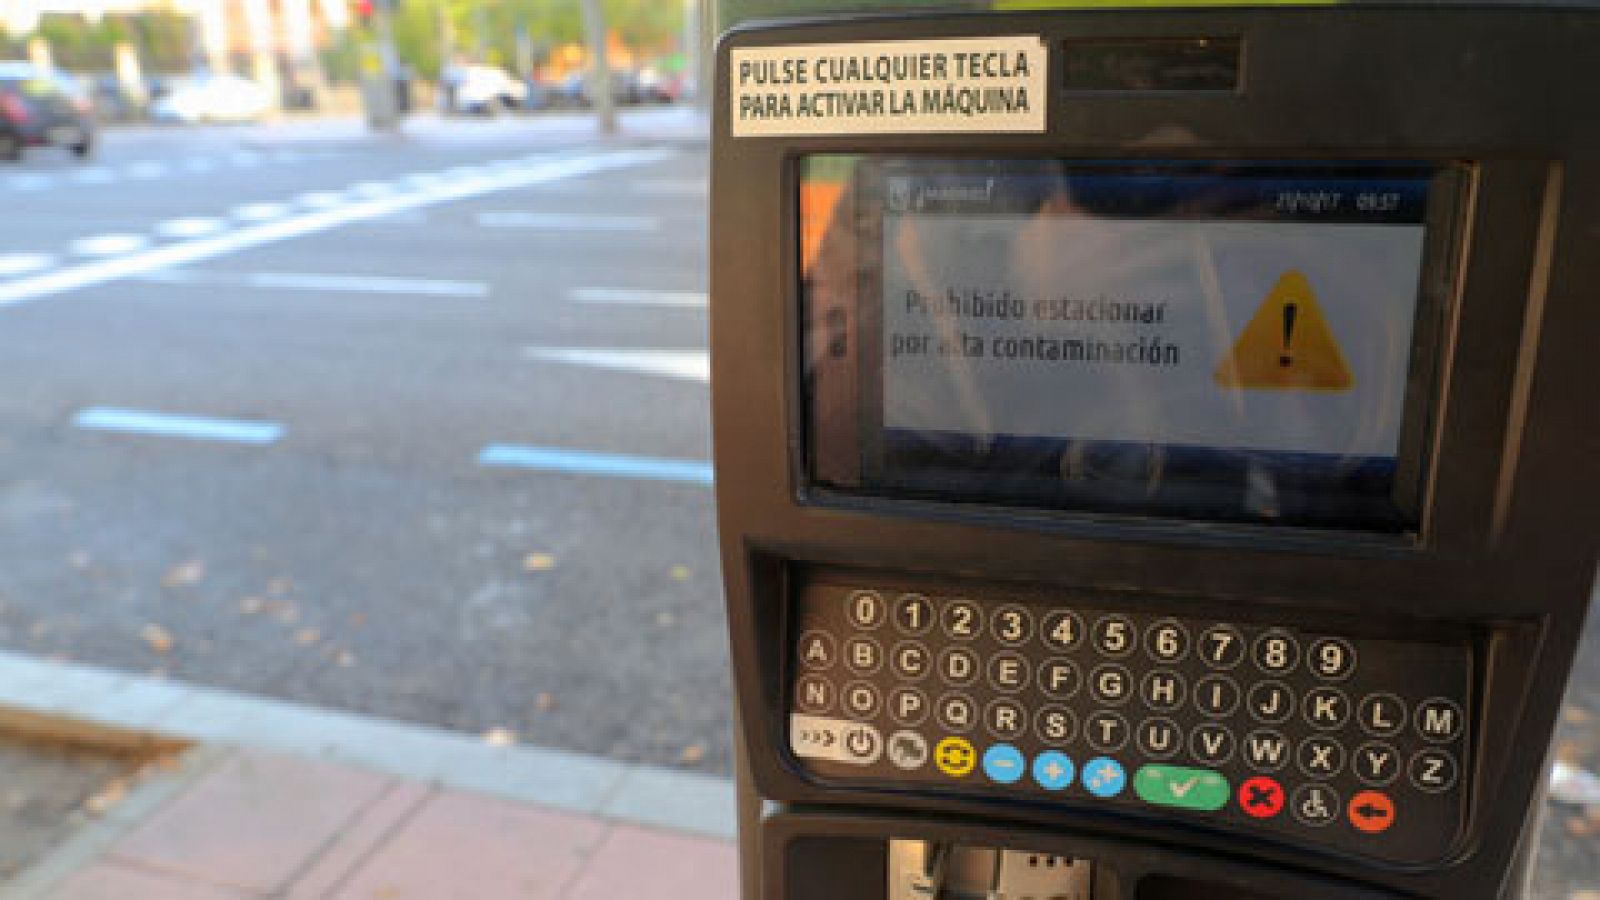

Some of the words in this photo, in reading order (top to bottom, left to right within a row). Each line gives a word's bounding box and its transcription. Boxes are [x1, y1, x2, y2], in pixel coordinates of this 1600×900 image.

[740, 59, 808, 84] PULSE
[815, 52, 948, 84] CUALQUIER
[953, 50, 1030, 78] TECLA
[740, 92, 792, 119] PARA
[796, 88, 884, 117] ACTIVAR
[889, 88, 917, 114] LA
[922, 83, 1030, 116] MÁQUINA
[1033, 295, 1166, 323] estacionar
[890, 334, 931, 359] por
[993, 335, 1180, 365] contaminación
[856, 596, 874, 624] 0
[906, 602, 919, 628] 1
[952, 606, 971, 634] 2
[1002, 612, 1021, 641] 3
[1052, 619, 1071, 645] 4
[1105, 622, 1124, 651] 5
[1156, 629, 1178, 655] 6
[1212, 633, 1231, 661] 7
[1265, 639, 1287, 668] 8
[1322, 645, 1341, 674] 9
[806, 639, 828, 661] A
[853, 642, 874, 667] B
[899, 649, 921, 671] C
[949, 653, 971, 678] D
[999, 659, 1018, 684] E
[1052, 666, 1069, 691] F
[1099, 672, 1121, 697] G
[1152, 679, 1174, 704] H
[1261, 692, 1278, 714] J
[1313, 696, 1337, 721] K
[1372, 702, 1391, 728] L
[1425, 709, 1451, 734] M
[806, 682, 824, 705] N
[852, 689, 874, 711] O
[899, 693, 921, 717] P
[946, 699, 968, 724] Q
[996, 706, 1017, 731] R
[1046, 712, 1065, 738] S
[1099, 719, 1118, 742] T
[1149, 726, 1171, 751] U
[1202, 732, 1224, 755] V
[1252, 739, 1284, 761] W
[1309, 745, 1331, 771] X
[1369, 752, 1388, 775] Y
[1422, 759, 1444, 784] Z
